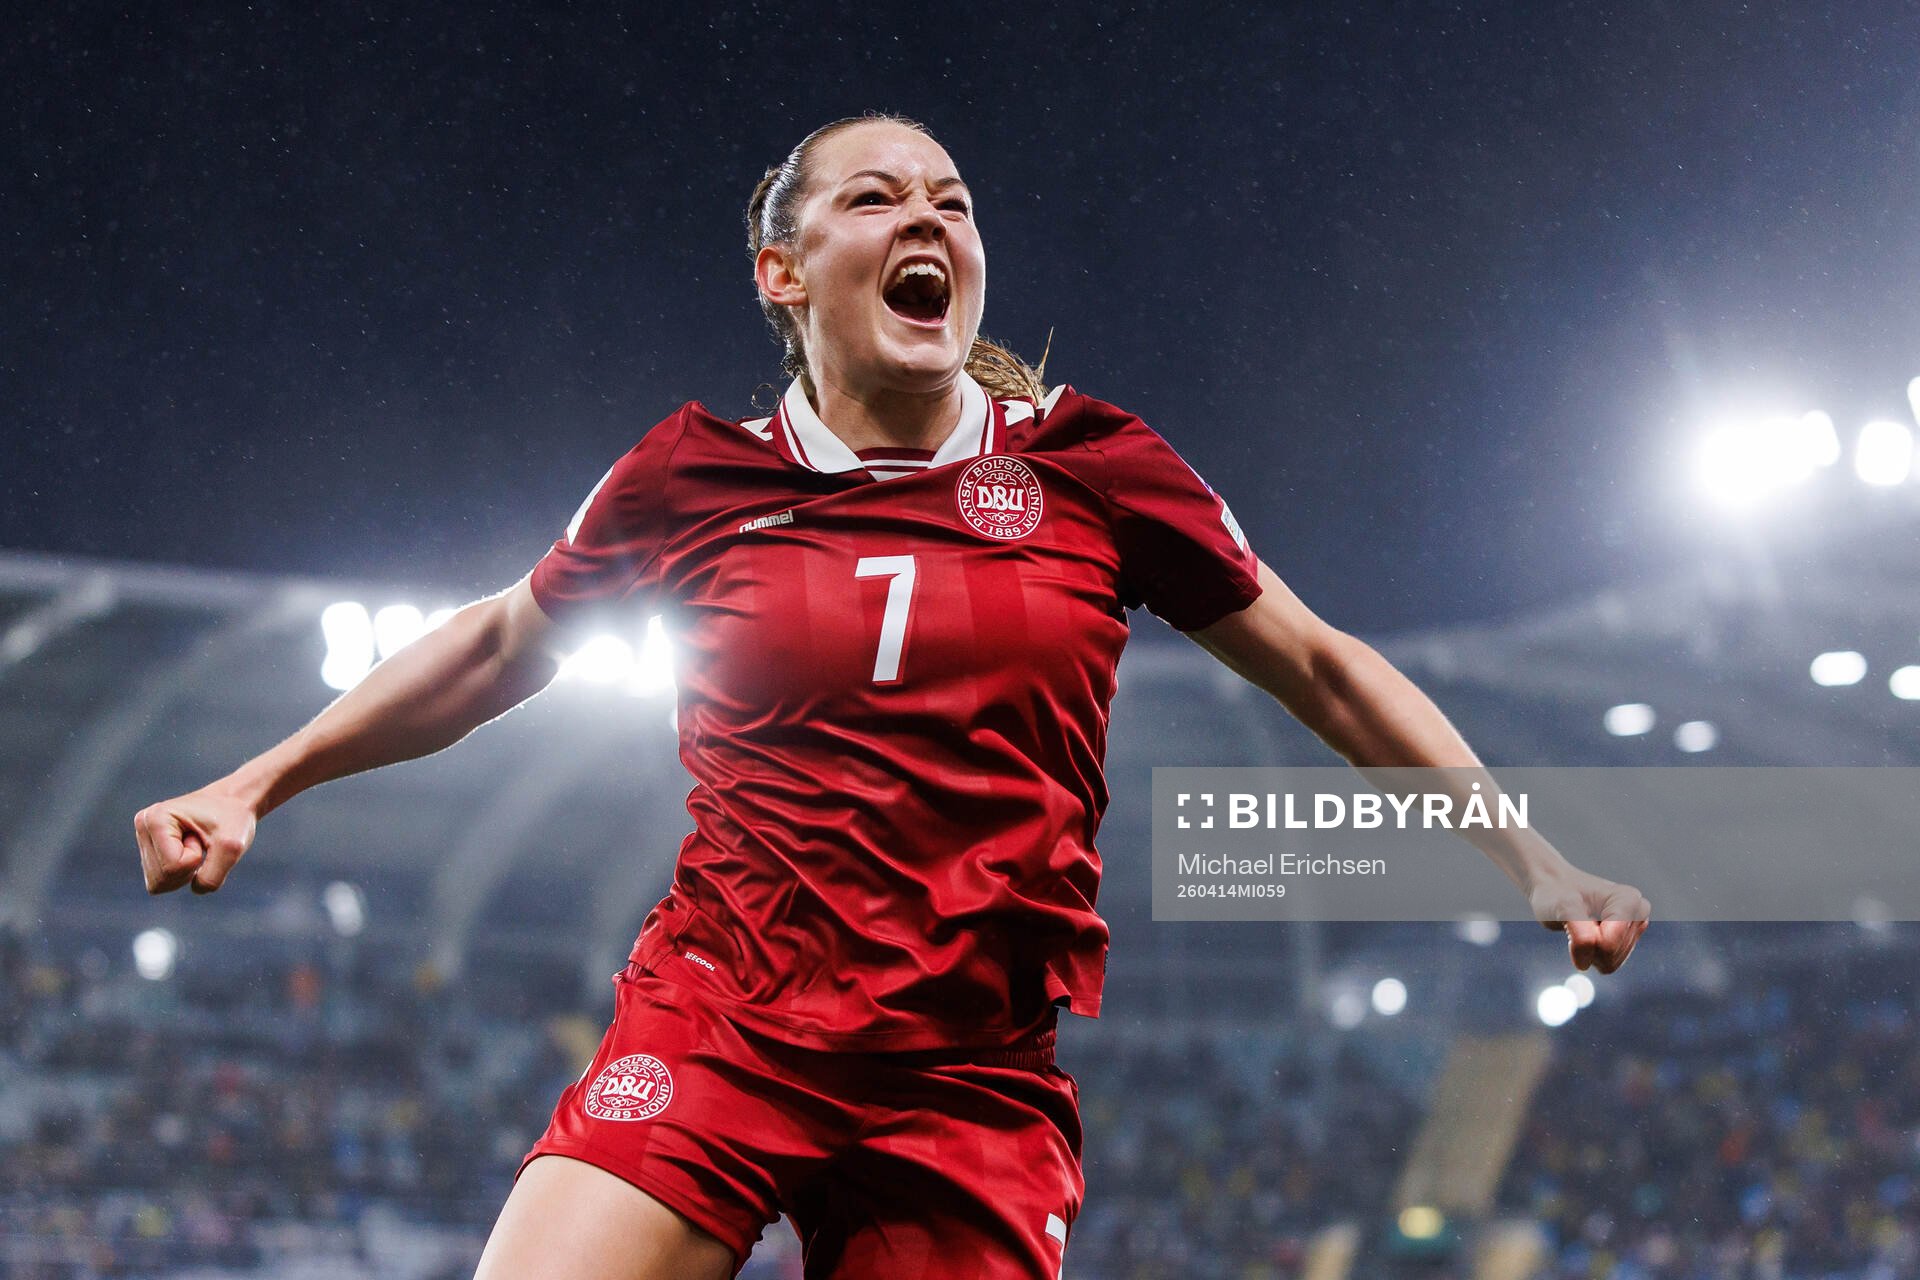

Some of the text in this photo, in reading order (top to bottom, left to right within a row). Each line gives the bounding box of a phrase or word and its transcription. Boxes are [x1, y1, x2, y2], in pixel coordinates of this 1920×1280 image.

[961, 479, 984, 528] DANSK
[988, 525, 1022, 537] 1889
[976, 485, 1026, 511] DBU
[854, 554, 916, 682] 7
[587, 1075, 608, 1112] DANSK
[600, 1075, 656, 1101] DBU
[596, 1108, 632, 1119] 1889
